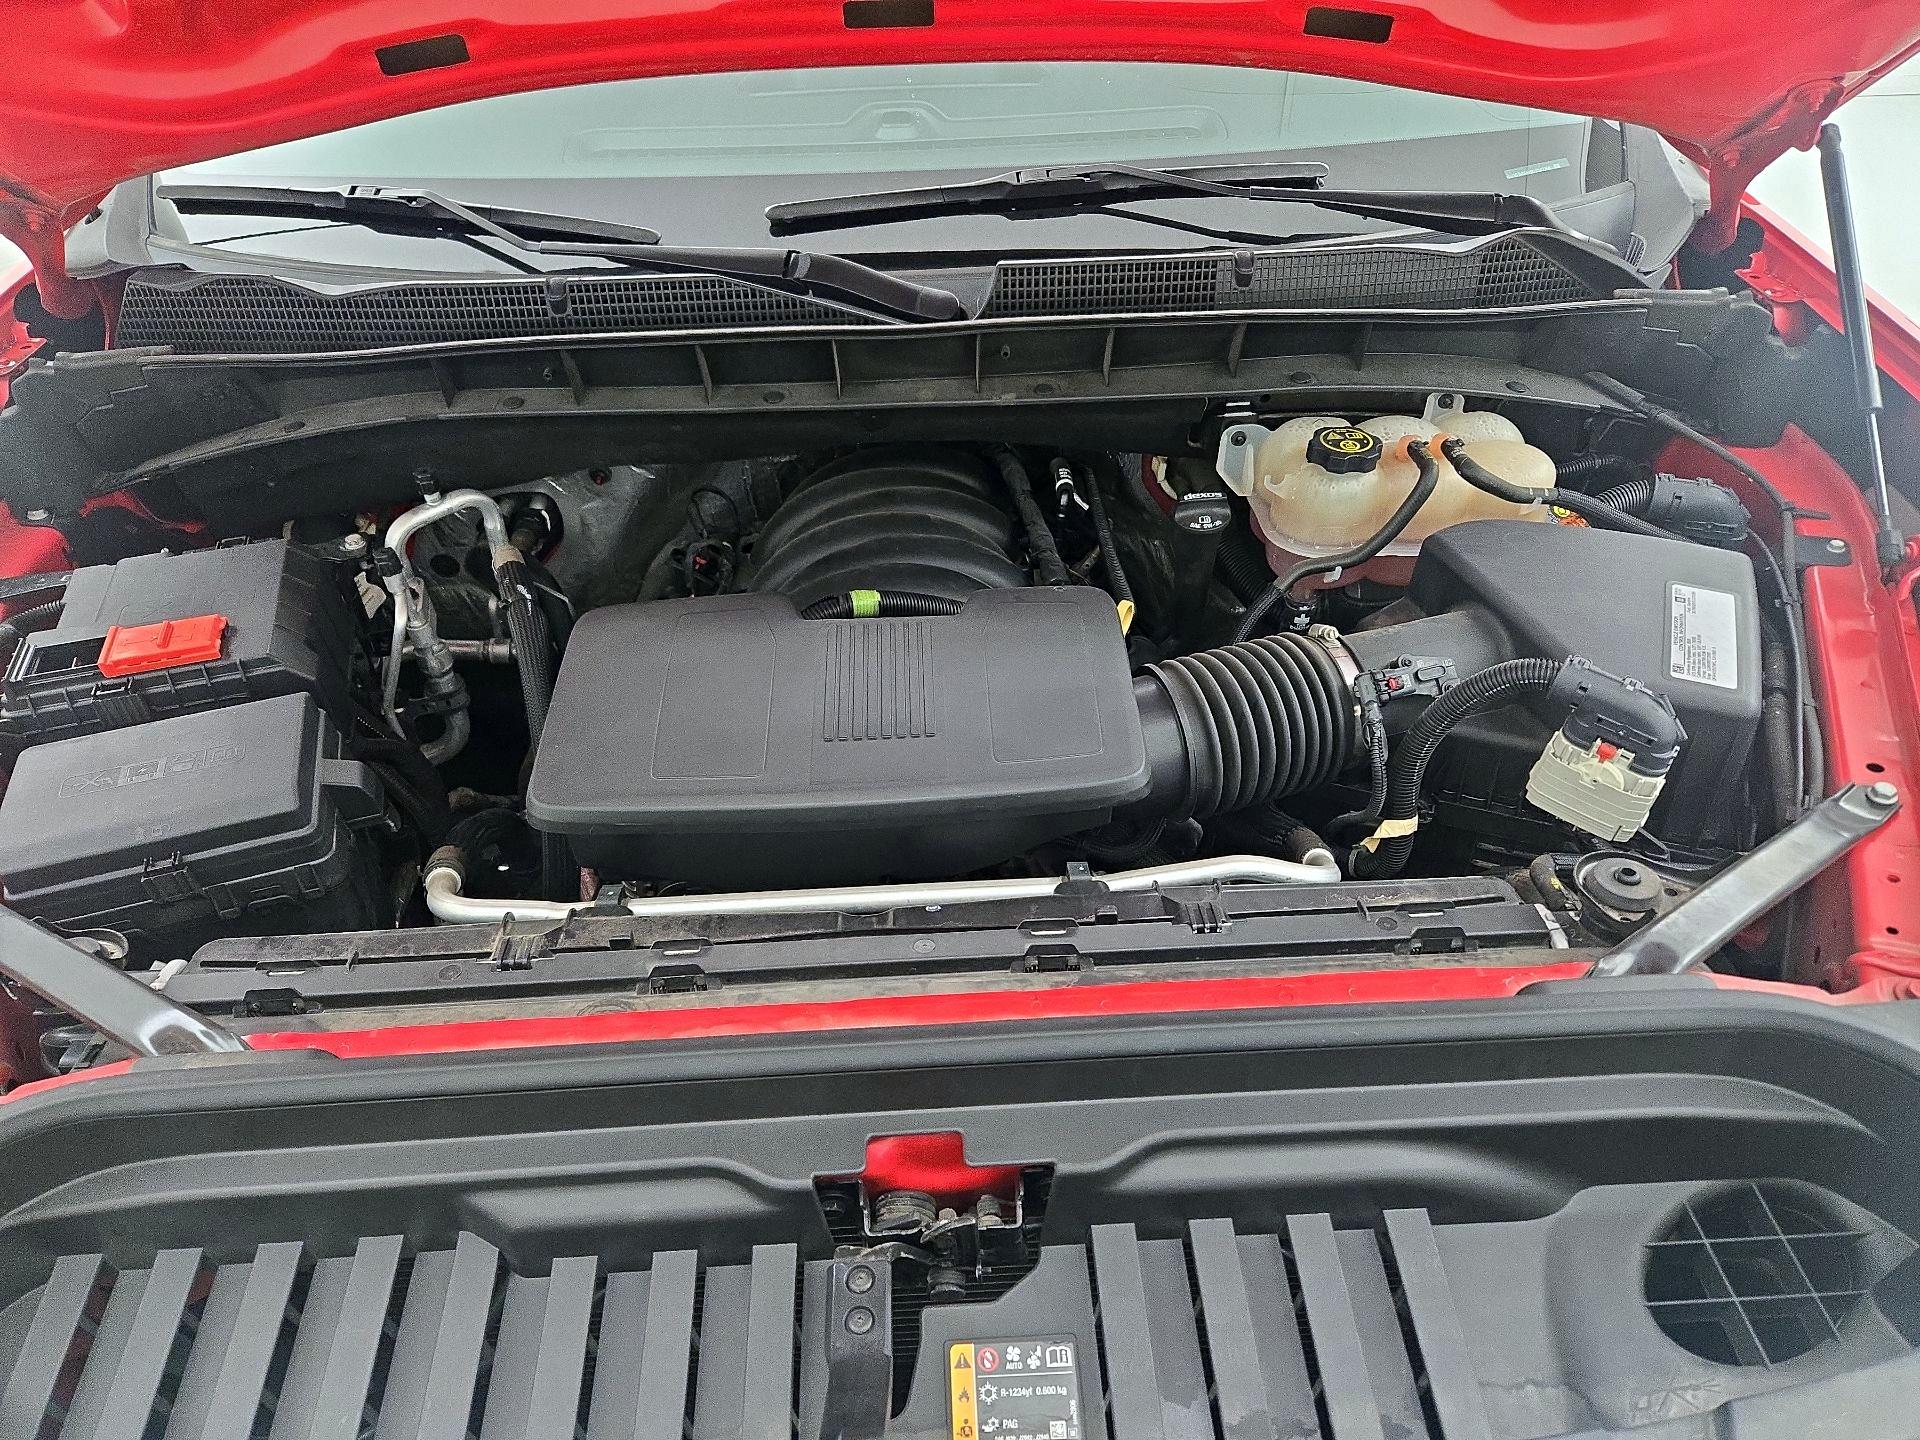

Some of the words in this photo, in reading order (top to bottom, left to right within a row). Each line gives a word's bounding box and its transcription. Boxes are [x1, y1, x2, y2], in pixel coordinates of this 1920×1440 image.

[1183, 492, 1223, 501] dexos
[1006, 1362, 1023, 1370] AUTO
[1000, 1386, 1033, 1398] R-1234yf
[1035, 1385, 1056, 1396] 0.600
[1057, 1385, 1068, 1396] kg
[1002, 1418, 1019, 1430] PAG
